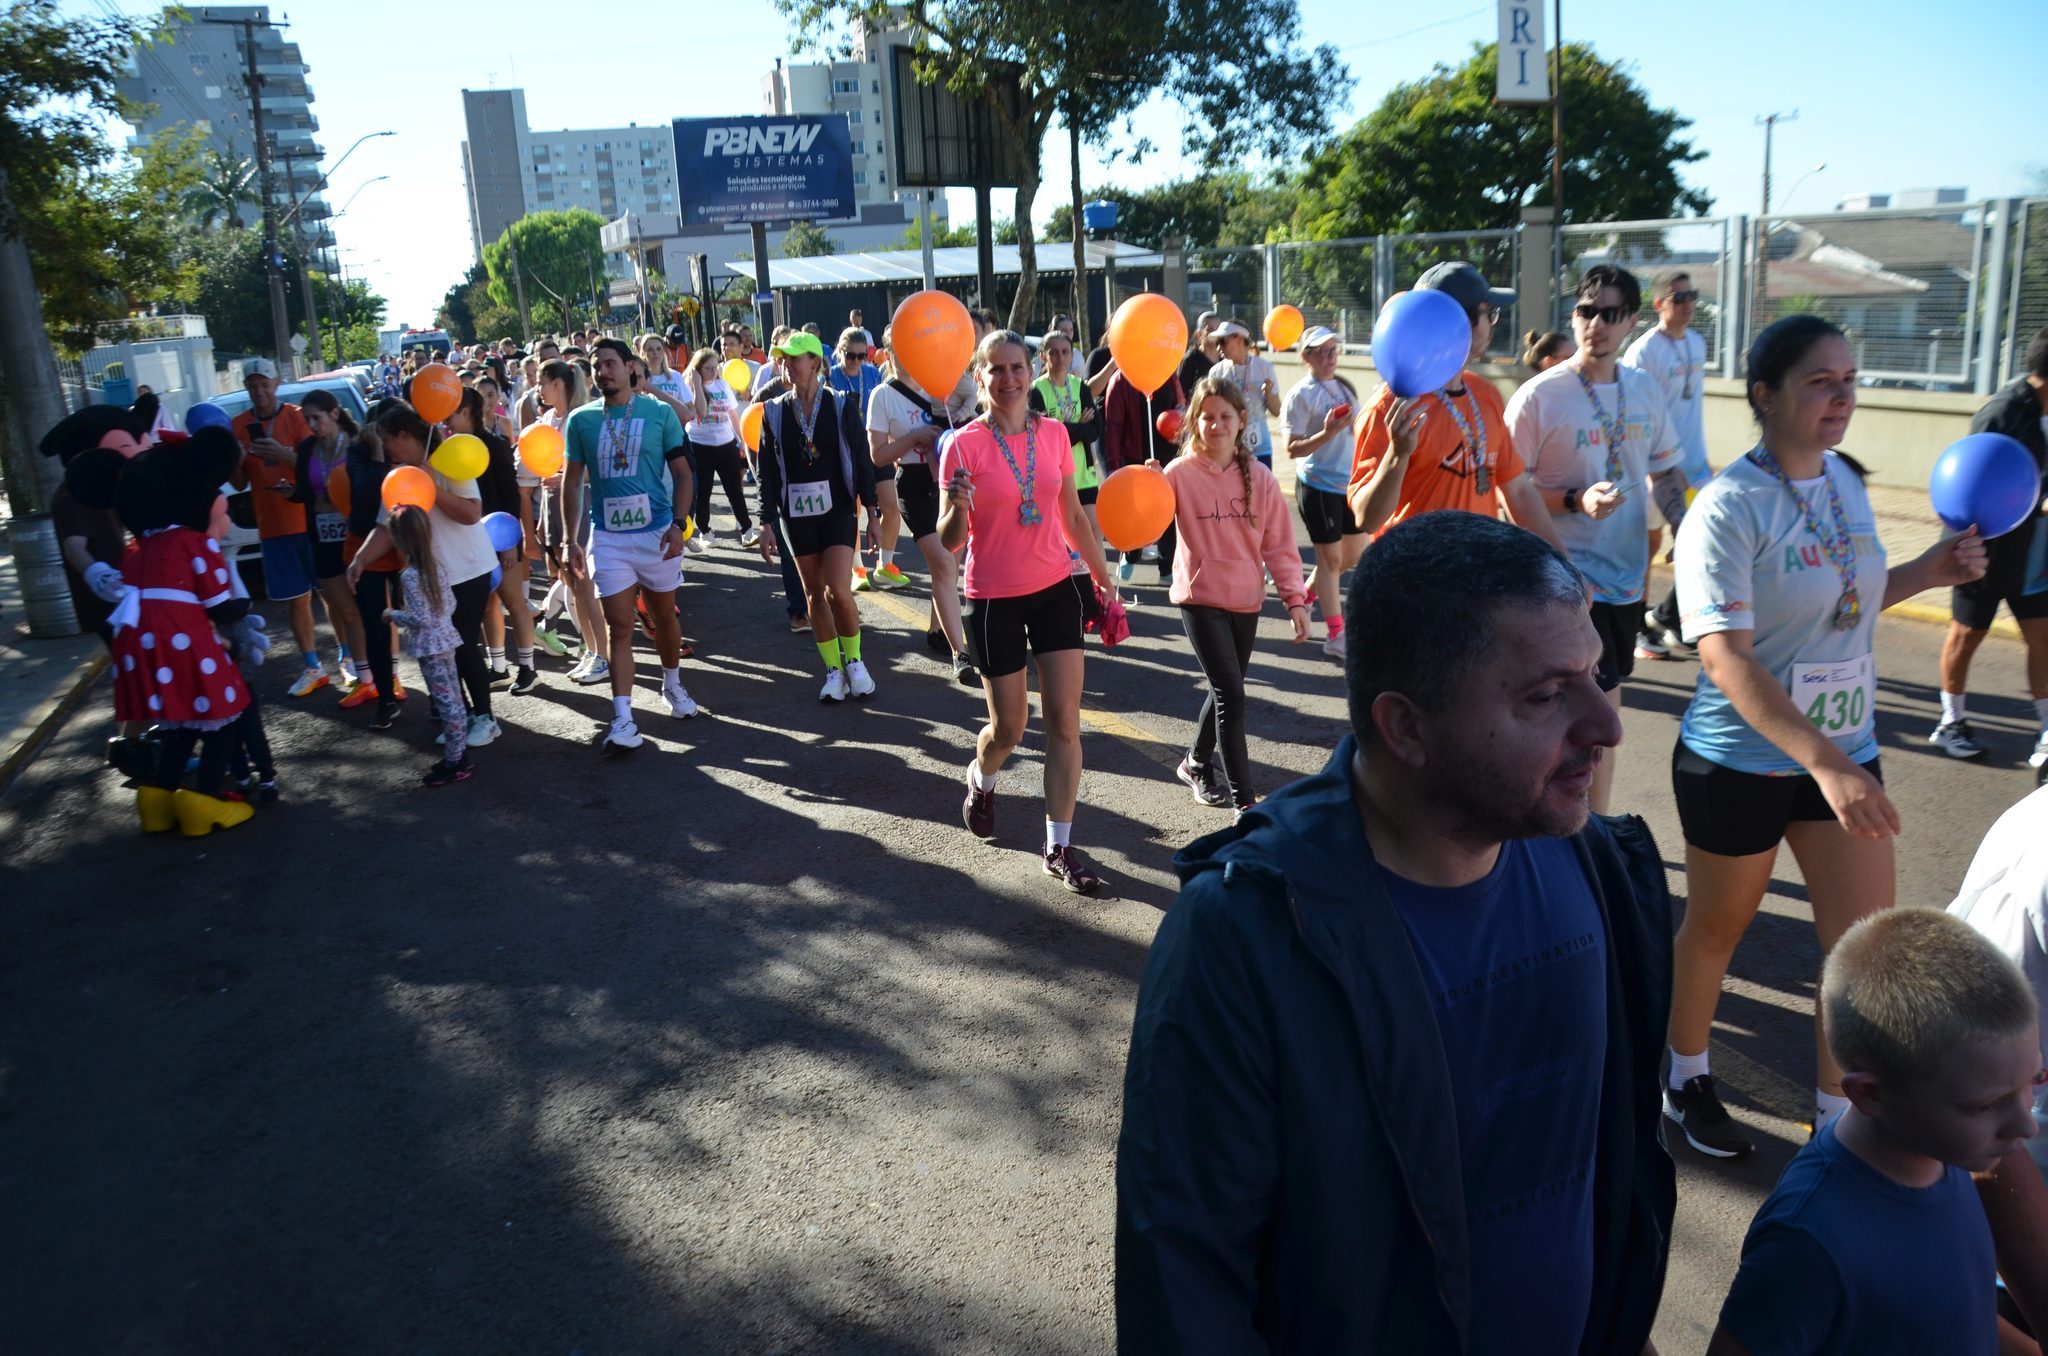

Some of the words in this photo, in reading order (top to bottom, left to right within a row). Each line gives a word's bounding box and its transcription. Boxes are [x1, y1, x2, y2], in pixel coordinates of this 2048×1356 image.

[1509, 0, 1536, 86] RI
[703, 123, 823, 157] PBNEW
[733, 154, 825, 168] SISTEMAS
[726, 175, 759, 185] Soluções
[760, 173, 806, 184] tecnológicas
[727, 185, 739, 193] em
[740, 182, 771, 194] produtos
[795, 494, 825, 513] 411
[610, 507, 646, 528] 444
[1806, 686, 1865, 731] 430
[1437, 976, 1485, 1006] YOUR
[1489, 932, 1595, 985] DESTINATION
